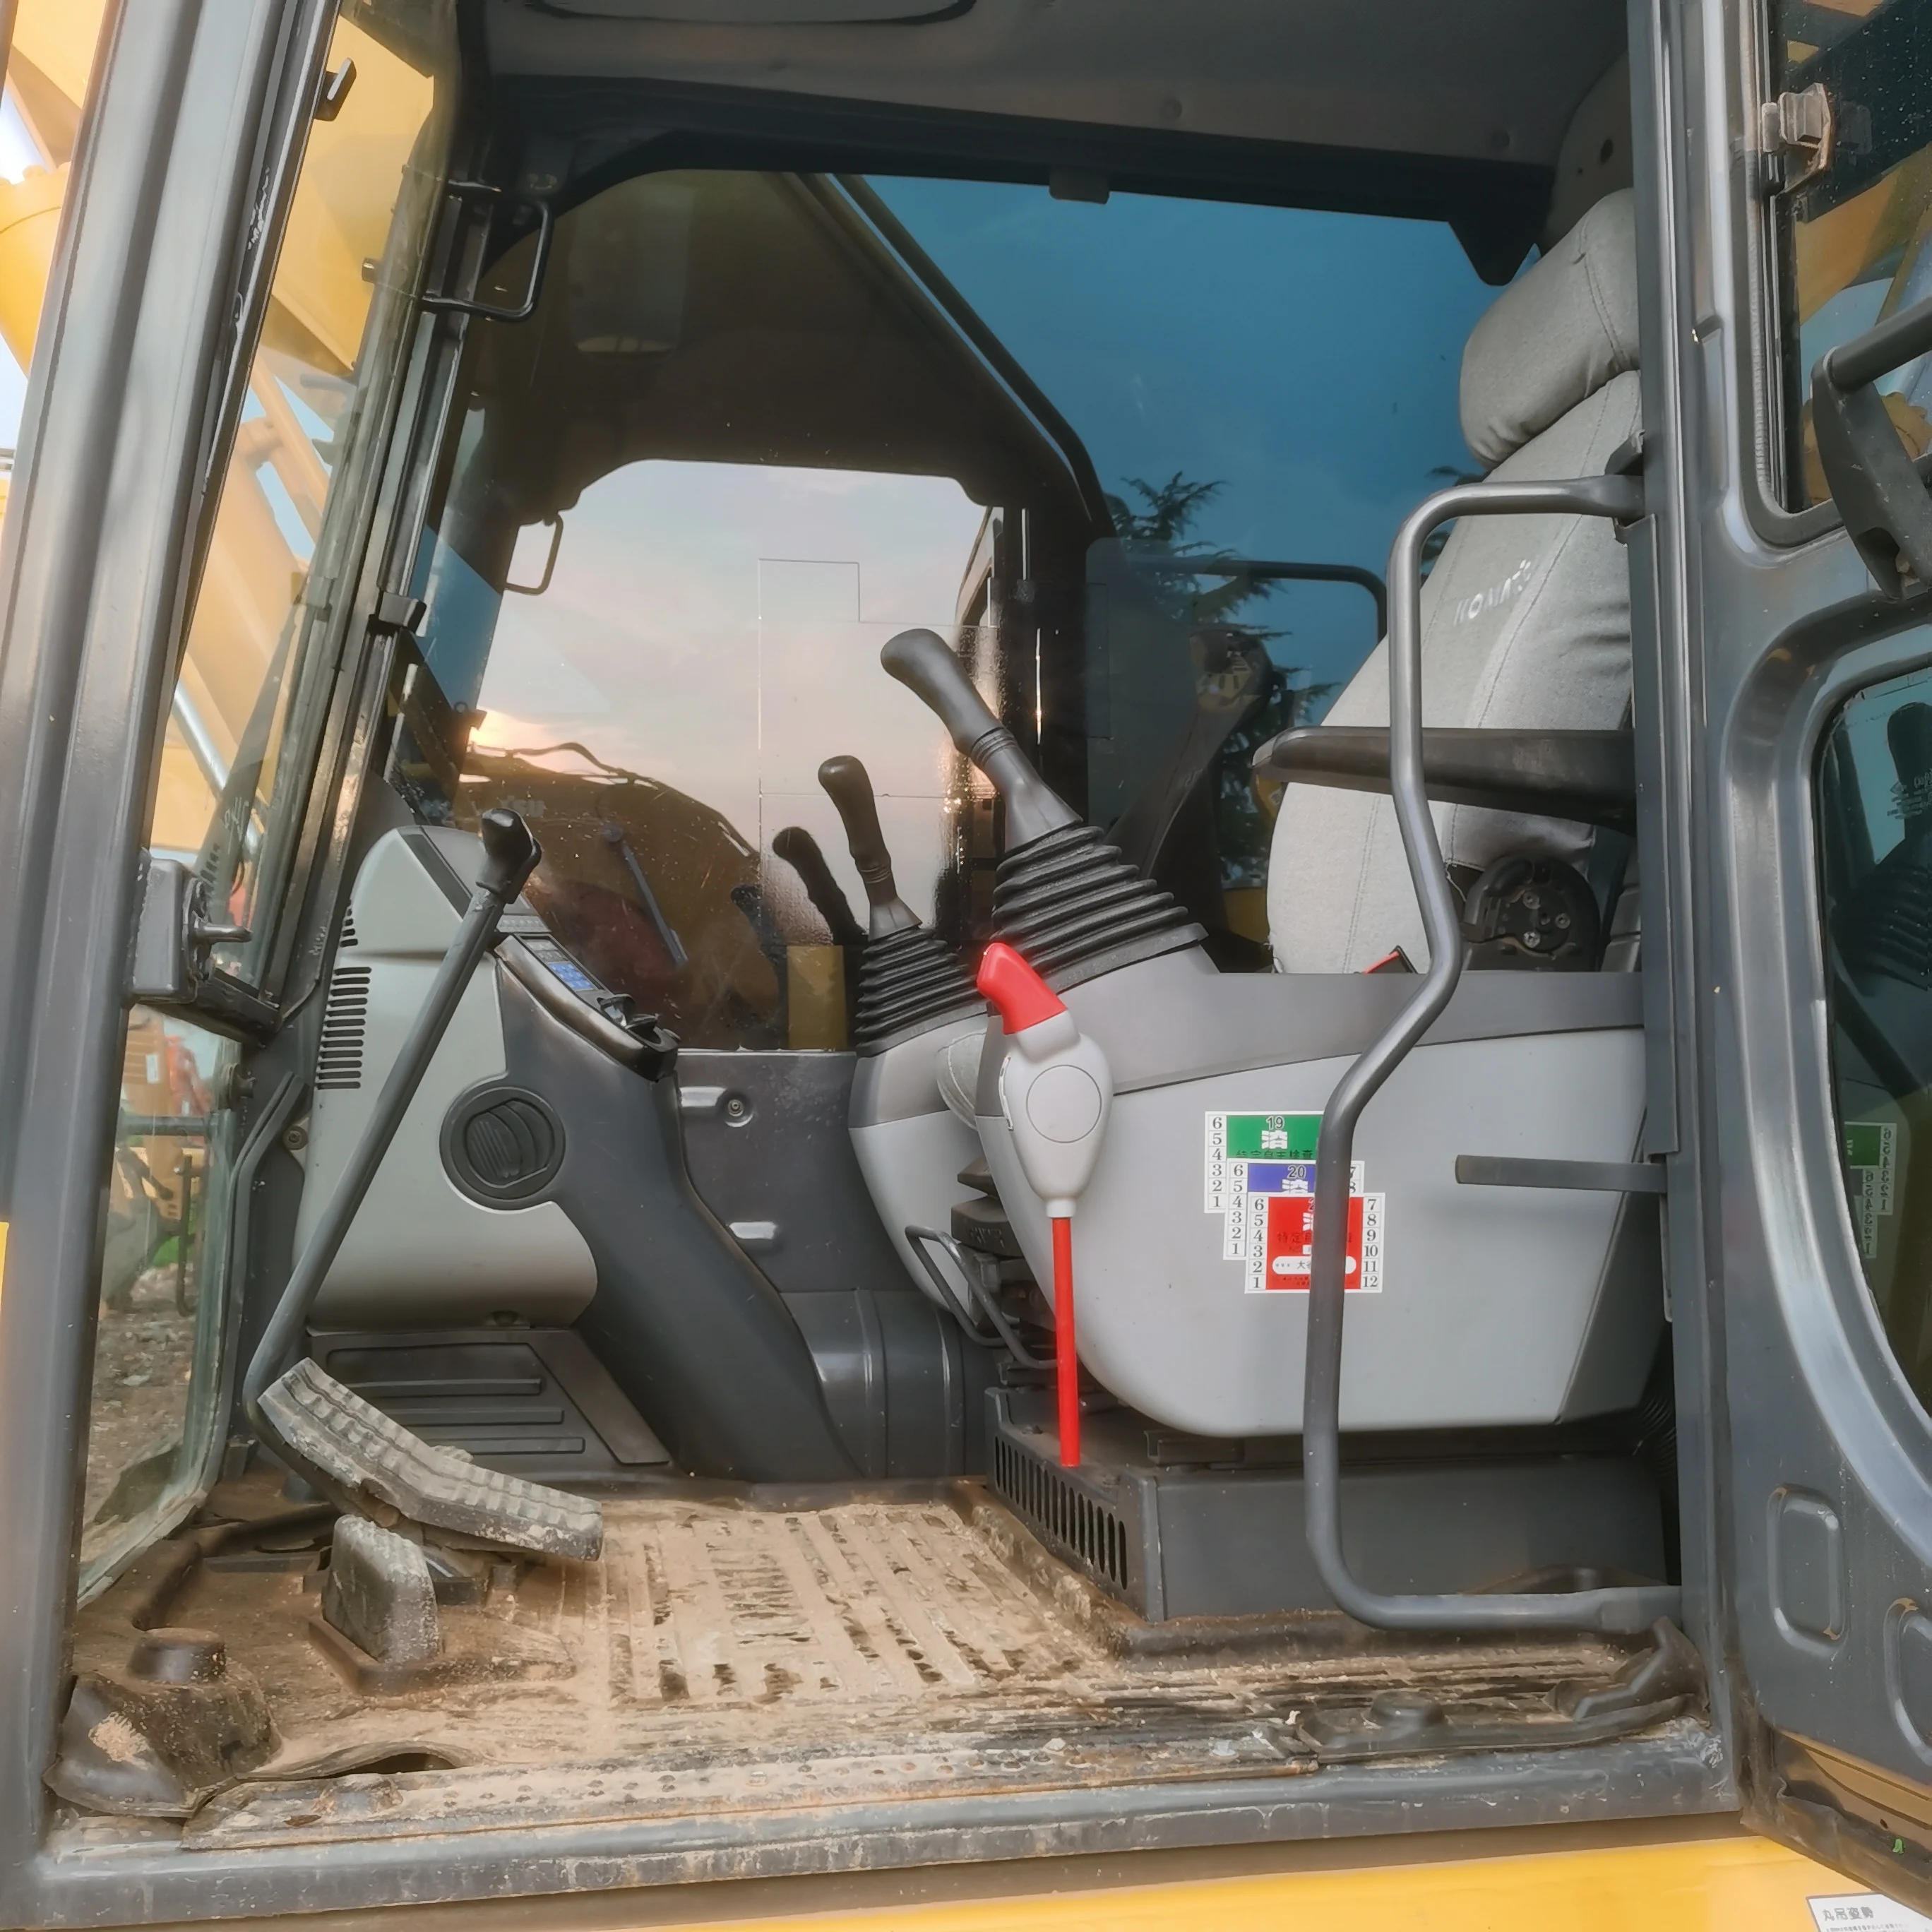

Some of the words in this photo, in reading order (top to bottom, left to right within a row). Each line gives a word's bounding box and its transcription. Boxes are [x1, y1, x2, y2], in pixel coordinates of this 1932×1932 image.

[1212, 1117, 1222, 1129] 6
[1266, 1116, 1284, 1130] 19
[1212, 1133, 1222, 1145] 5
[1261, 1130, 1288, 1149] 済
[1212, 1148, 1222, 1160] 4
[1212, 1164, 1222, 1176] 3
[1234, 1164, 1243, 1176] 6
[1287, 1165, 1306, 1179] 20
[1212, 1180, 1222, 1191] 2
[1234, 1180, 1242, 1192] 5
[1215, 1196, 1220, 1207] 1
[1233, 1195, 1241, 1208] 4
[1255, 1198, 1264, 1210] 6
[1368, 1199, 1376, 1210] 7
[1232, 1212, 1241, 1223] 3
[1254, 1214, 1263, 1226] 5
[1367, 1214, 1376, 1226] 8
[1232, 1227, 1241, 1239] 2
[1253, 1230, 1263, 1241] 4
[1367, 1229, 1376, 1241] 9
[1232, 1243, 1238, 1254] 1
[1253, 1245, 1263, 1257] 3
[1365, 1245, 1378, 1256] 10
[1253, 1261, 1262, 1272] 2
[1364, 1260, 1376, 1272] 11
[1254, 1277, 1260, 1288] 1
[1364, 1276, 1378, 1287] 12
